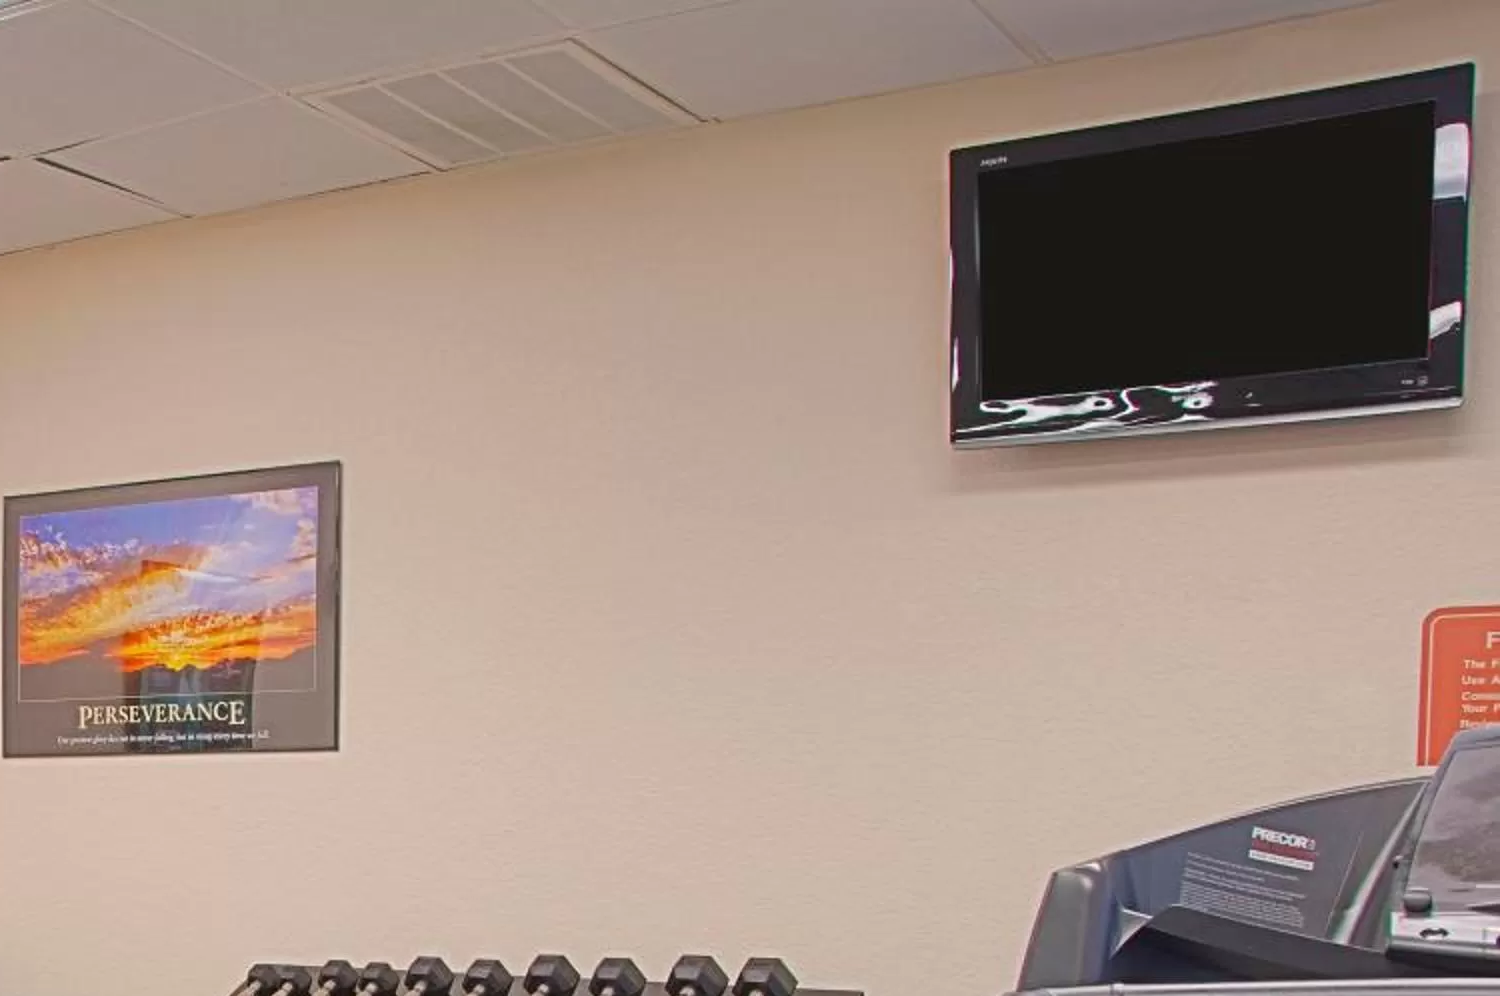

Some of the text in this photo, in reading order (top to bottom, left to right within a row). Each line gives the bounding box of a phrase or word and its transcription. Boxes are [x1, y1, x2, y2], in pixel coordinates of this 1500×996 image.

[1463, 659, 1486, 669] The
[1461, 675, 1485, 686] Use
[1461, 703, 1489, 713] Your
[78, 700, 248, 729] PERSEVERANCE
[1251, 827, 1308, 849] PRECOR
